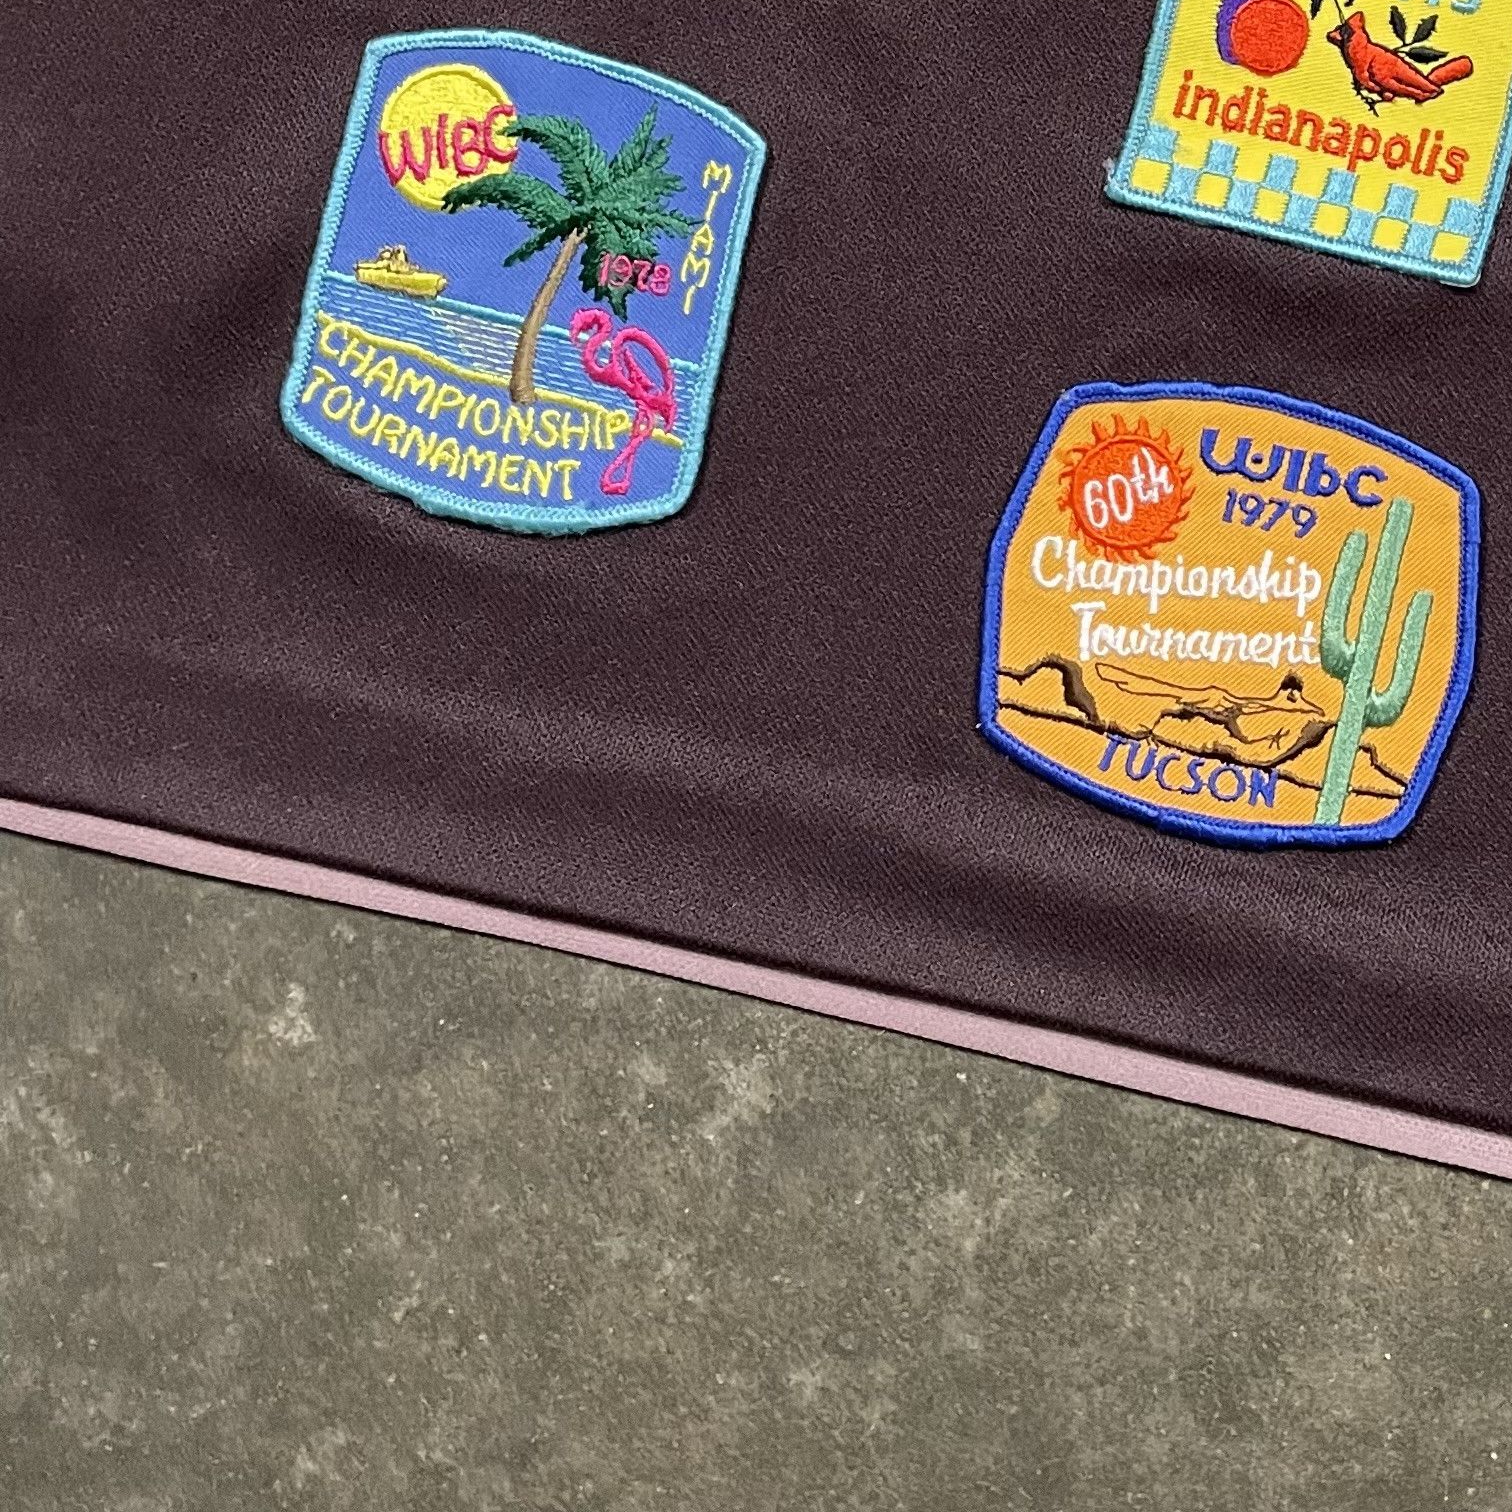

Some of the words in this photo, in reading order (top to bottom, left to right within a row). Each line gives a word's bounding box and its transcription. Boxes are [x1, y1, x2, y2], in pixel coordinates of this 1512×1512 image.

[377, 104, 519, 186] WIBC
[1172, 70, 1470, 185] indianapolis
[598, 251, 673, 297] 1978
[681, 160, 732, 316] MIAMI
[318, 323, 632, 451] CHAMPIONSHIP
[301, 367, 582, 501] TOURNAMENT
[1083, 446, 1175, 529] 60th
[1221, 489, 1319, 539] 1979
[1030, 535, 1323, 618] Championship
[1070, 600, 1320, 670] Tournament
[1098, 733, 1280, 808] TUCSON
